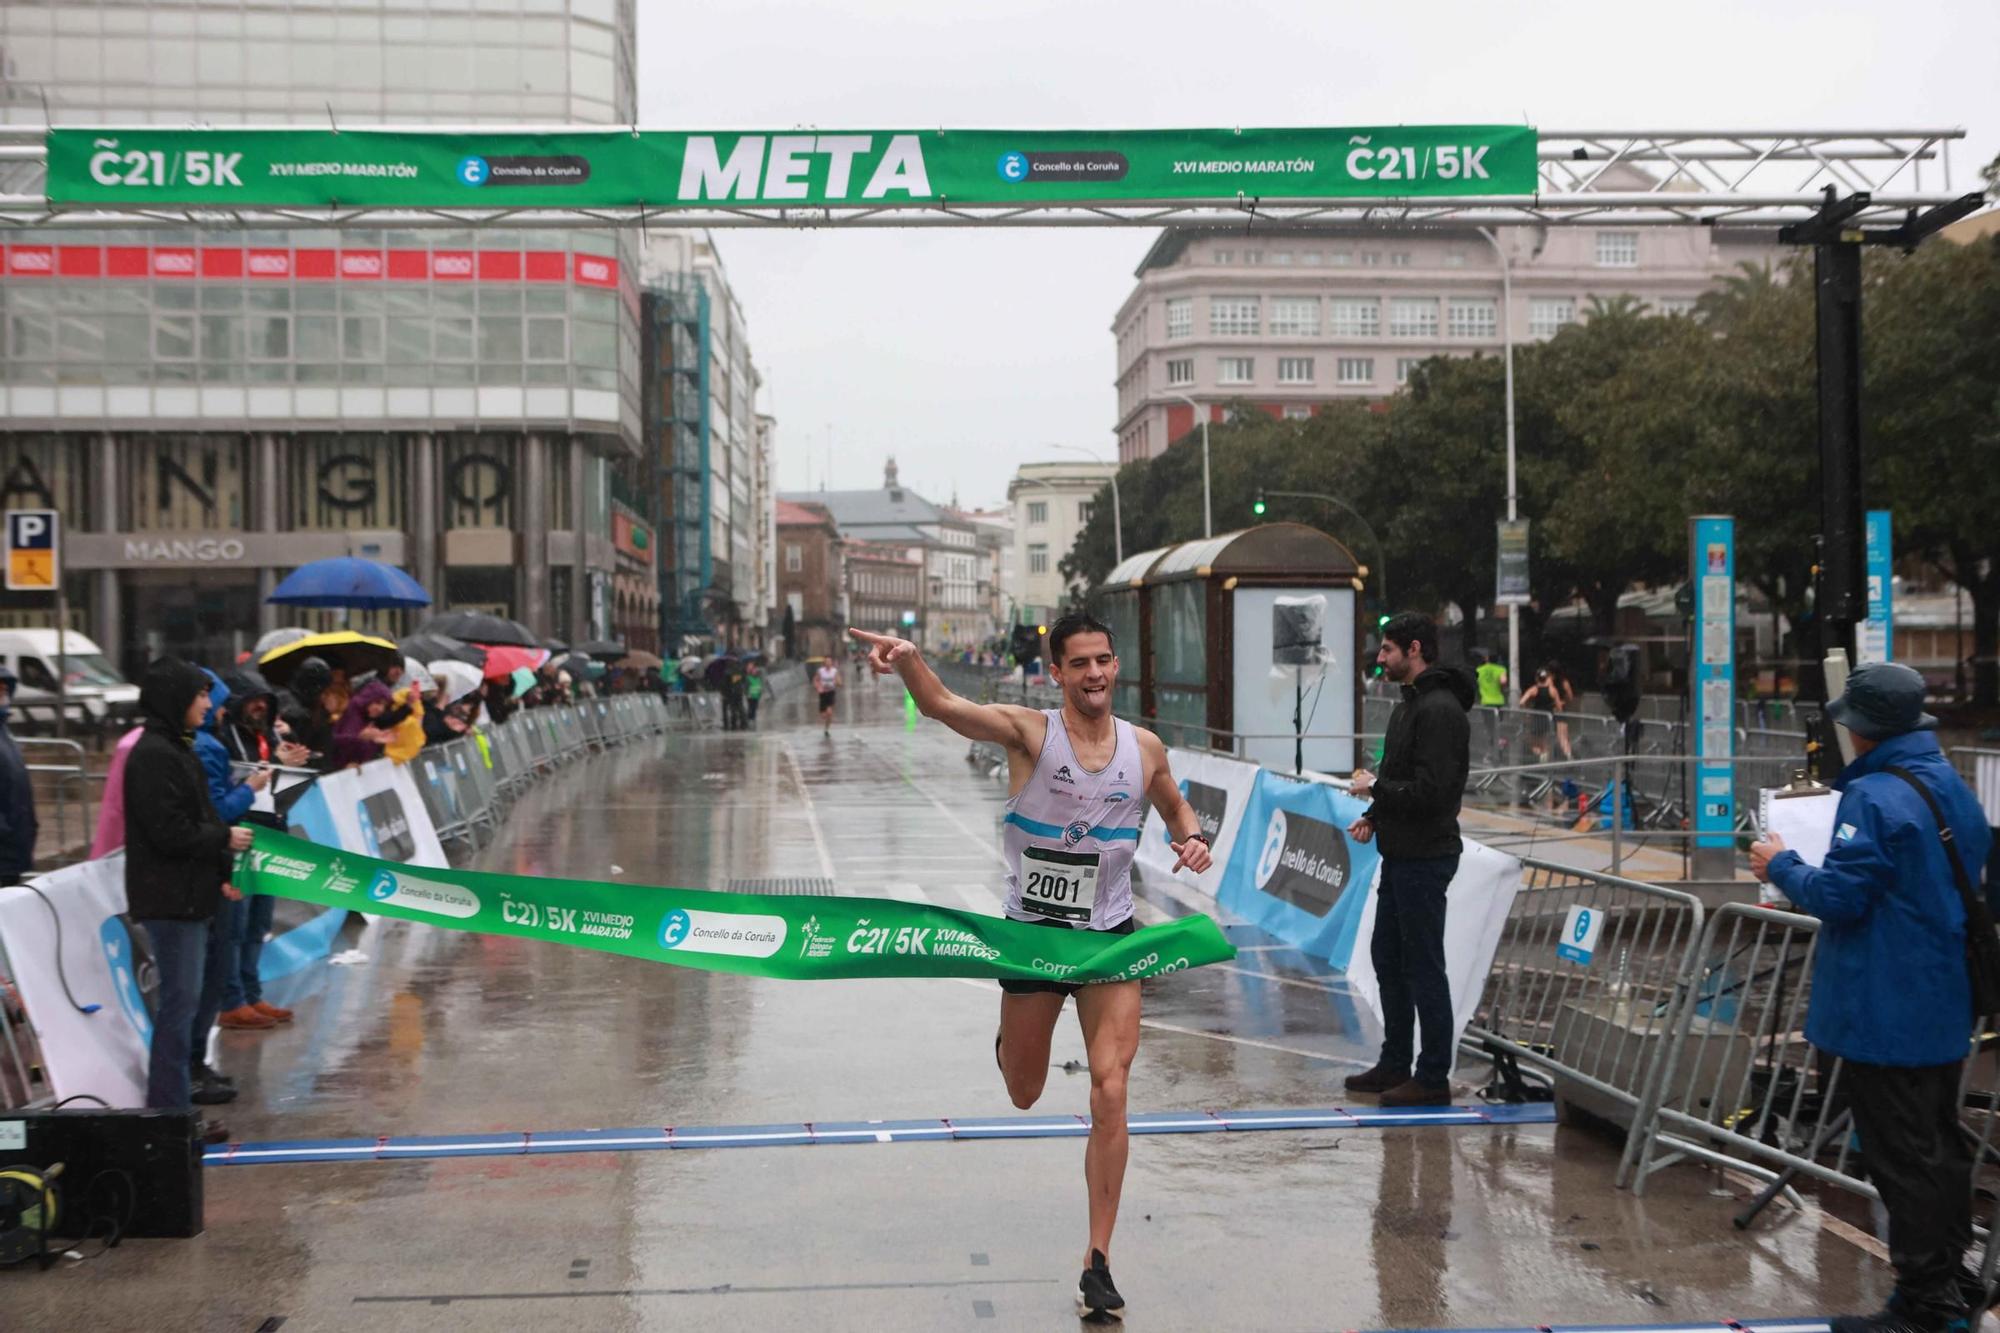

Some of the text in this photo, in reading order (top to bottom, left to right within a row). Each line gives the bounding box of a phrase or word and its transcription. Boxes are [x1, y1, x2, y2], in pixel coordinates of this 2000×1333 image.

[296, 162, 340, 176] MEDIO
[342, 160, 418, 178] MARATÓN
[492, 165, 582, 177] Concello da Coruña
[677, 134, 932, 200] META
[1033, 161, 1120, 172] Concello da Coruña
[1172, 157, 1315, 173] XVI MEDIO MARATÓN
[18, 516, 46, 547] P
[124, 539, 244, 560] MANGO
[1315, 858, 1343, 888] Coruña
[1026, 871, 1080, 904] 2001
[582, 911, 601, 923] XVI
[692, 927, 776, 943] Concello da Coruña
[934, 928, 958, 941] XVI
